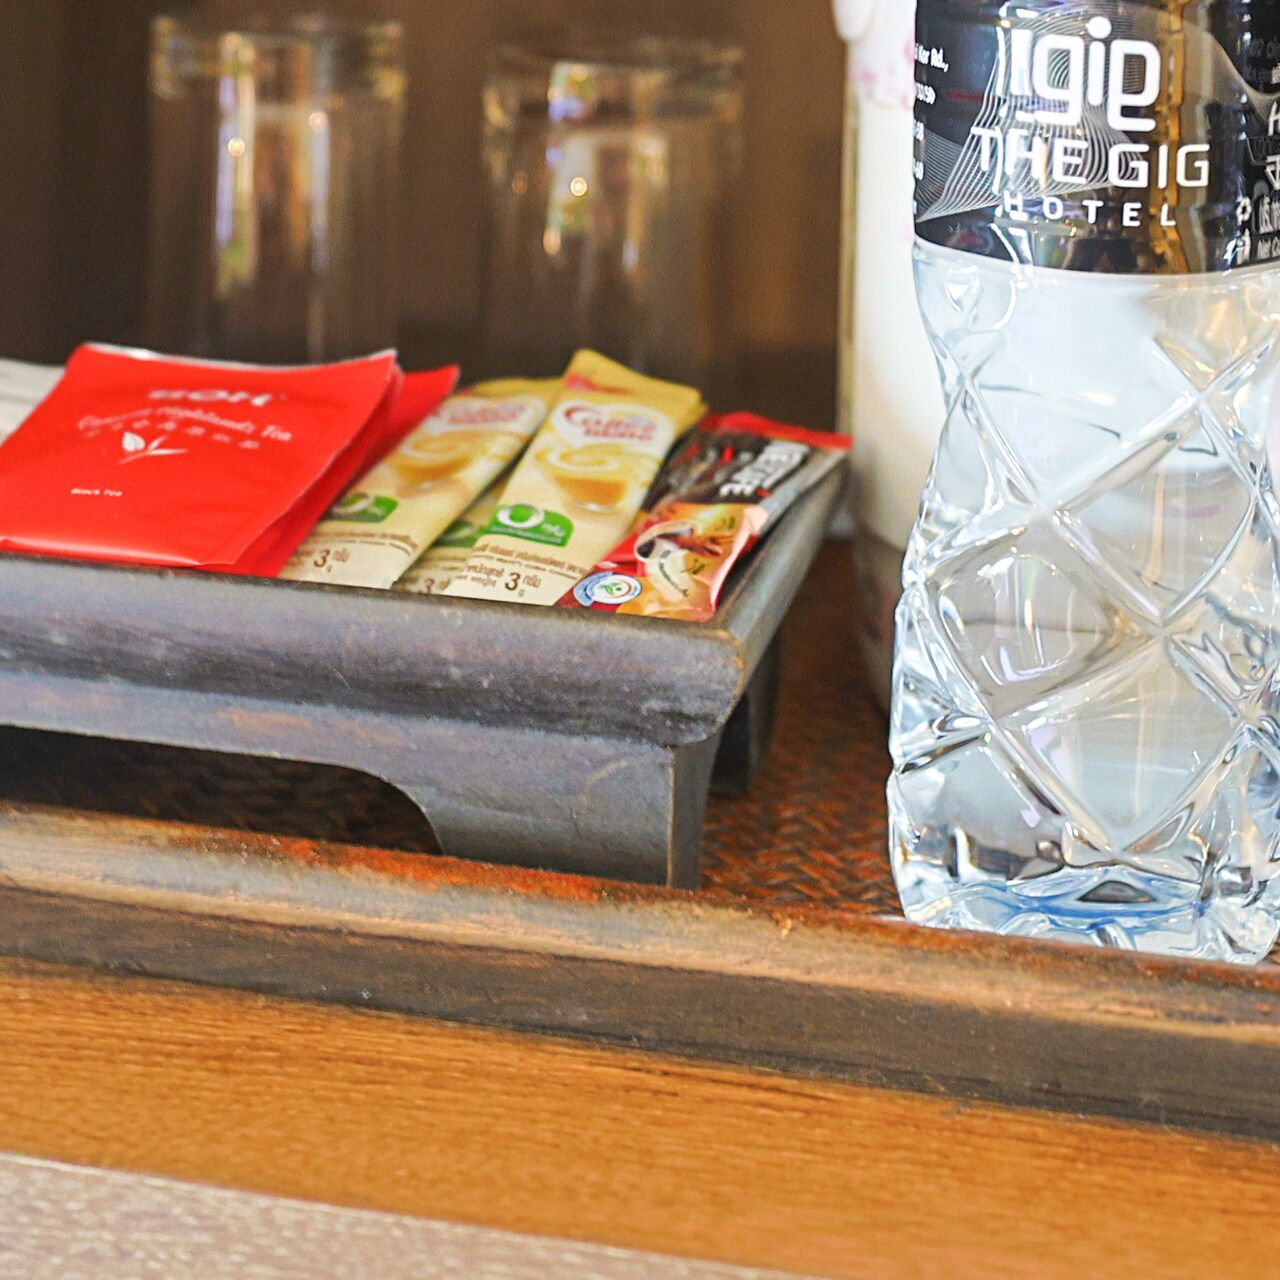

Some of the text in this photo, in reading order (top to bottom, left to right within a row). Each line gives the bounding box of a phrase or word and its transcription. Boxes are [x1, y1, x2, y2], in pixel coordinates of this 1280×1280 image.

[970, 125, 1210, 188] THE GIG
[1003, 190, 1178, 228] HOTEL
[504, 572, 521, 592] 3
